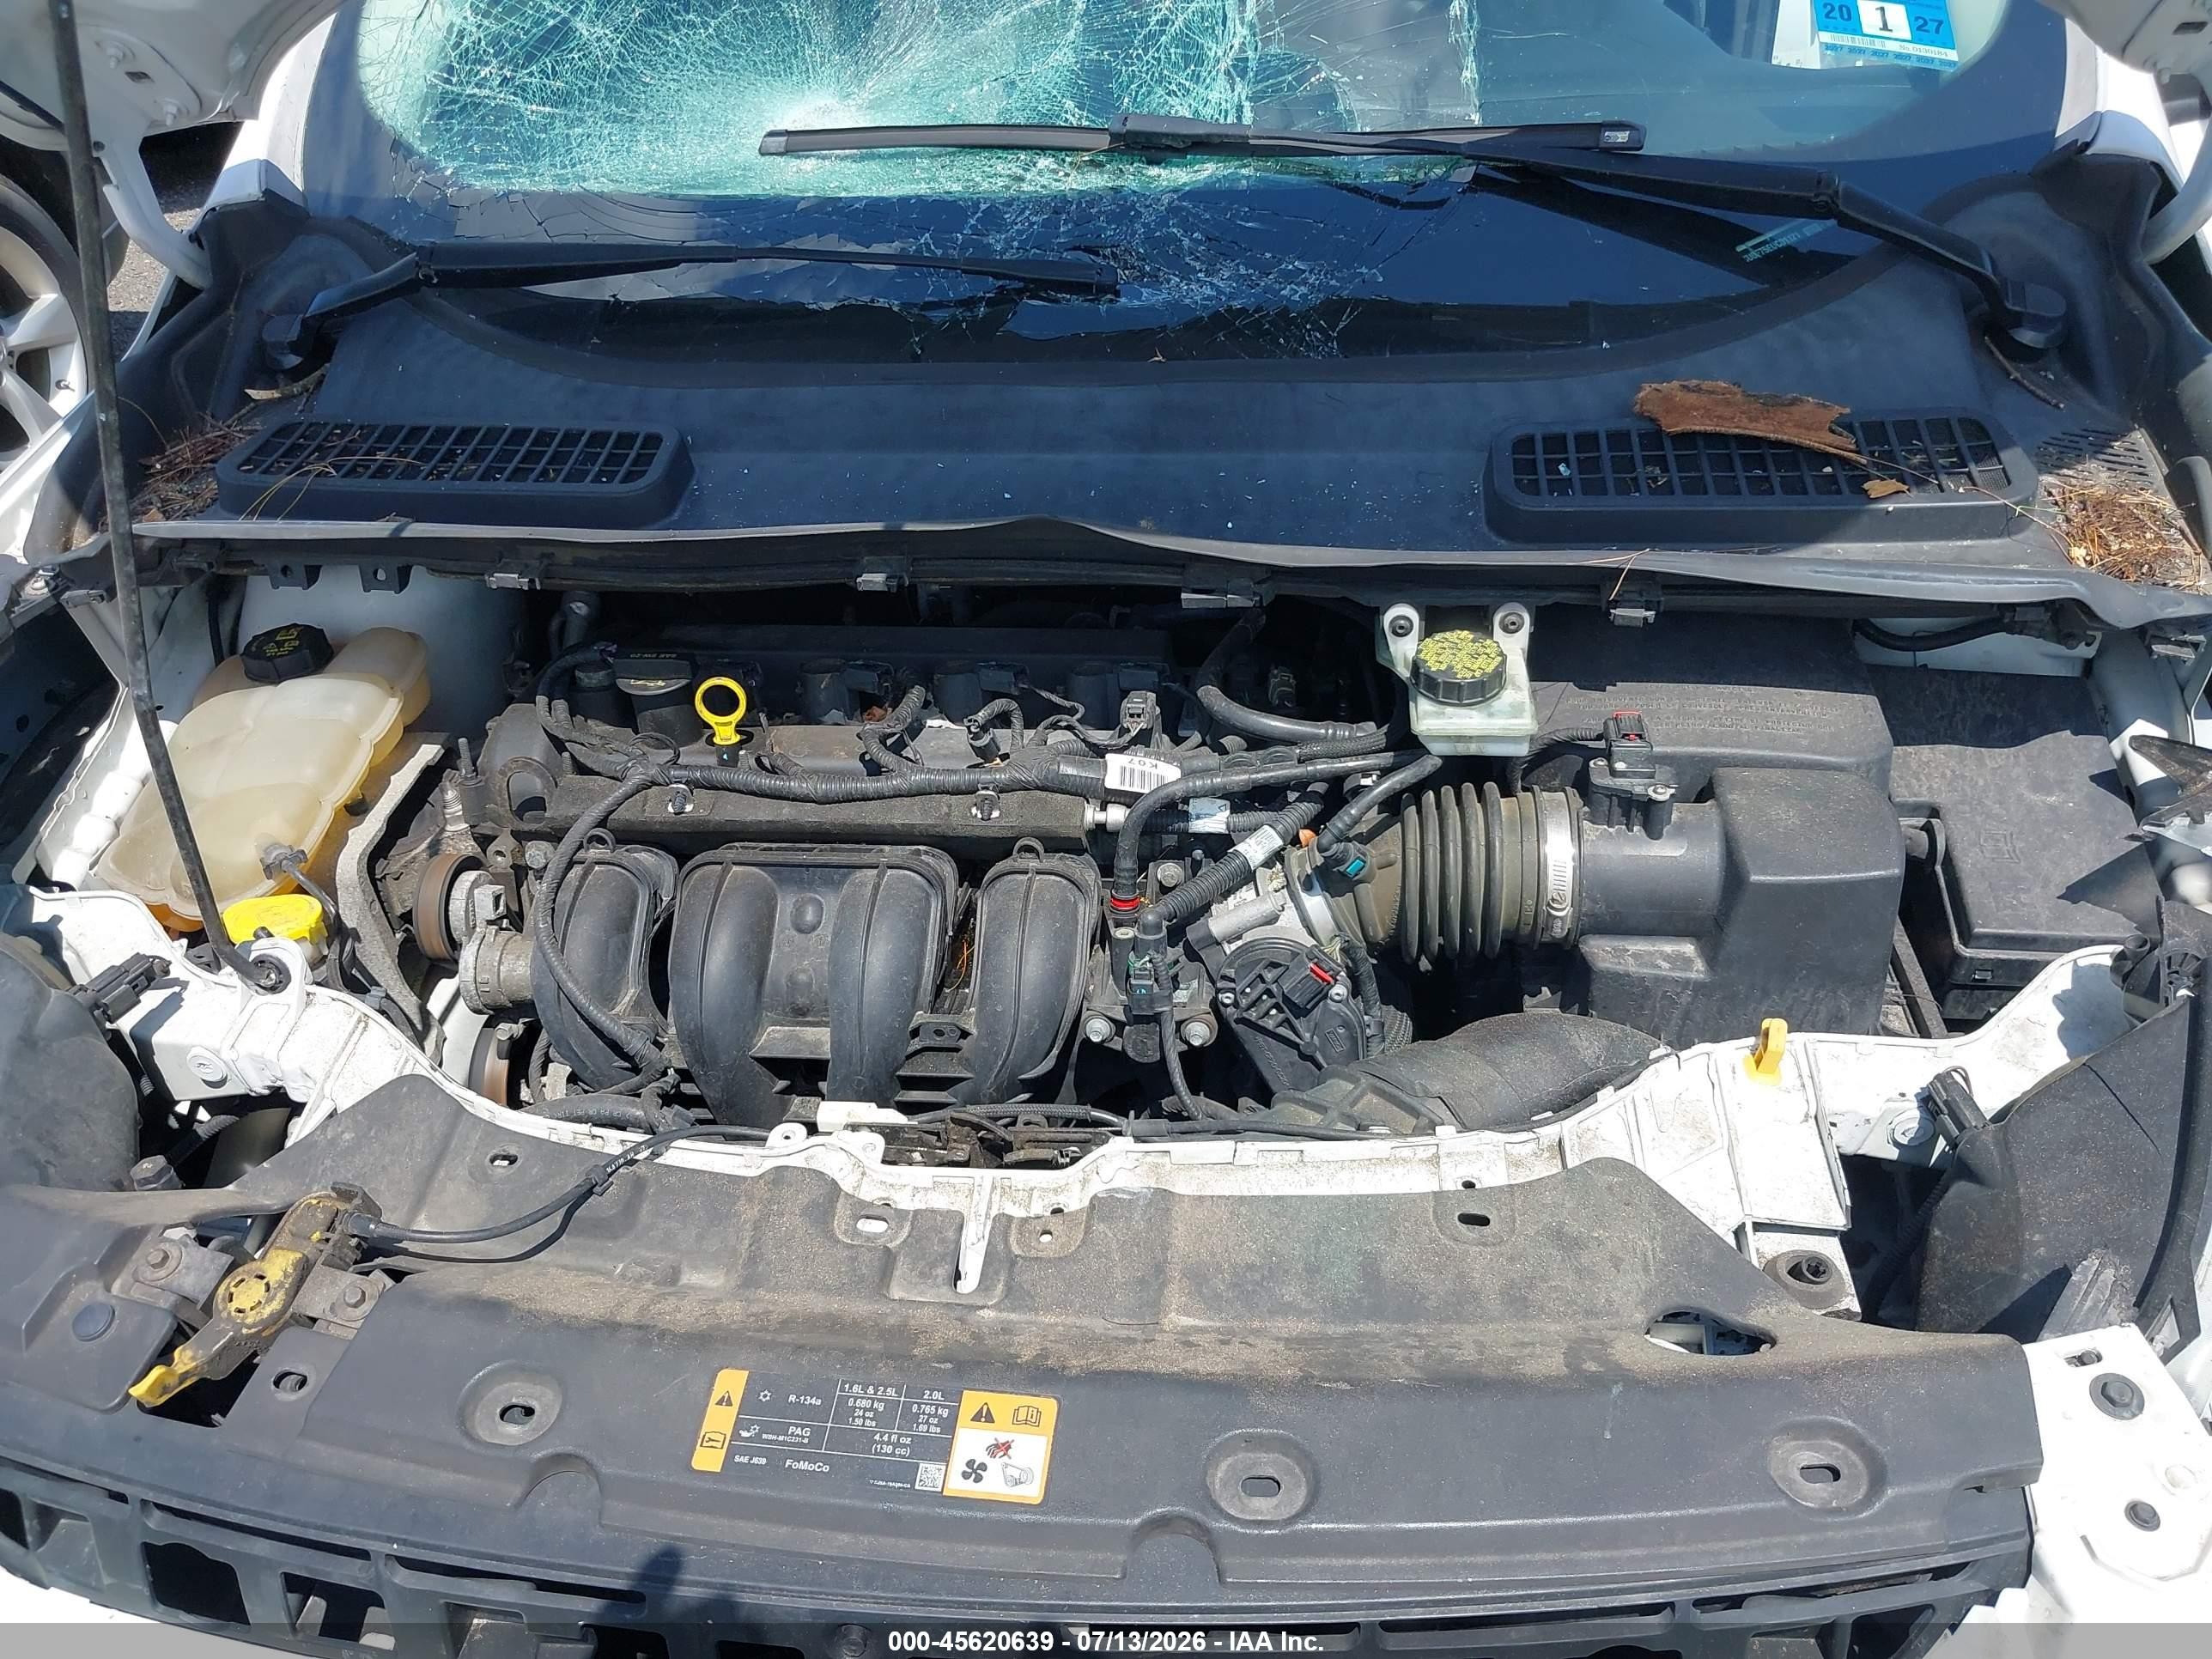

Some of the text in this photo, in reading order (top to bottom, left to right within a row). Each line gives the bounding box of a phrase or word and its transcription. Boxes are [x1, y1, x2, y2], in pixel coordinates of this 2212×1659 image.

[1823, 2, 1944, 35] 20 1 27
[843, 1382, 945, 1401] 1.6L & 2.5L 2.0L
[788, 1394, 822, 1407] R-134a
[848, 1398, 884, 1412] 0.680 kg
[912, 1404, 949, 1418] 0.765 kg
[865, 1419, 876, 1427] lbs
[929, 1425, 940, 1433] lbs
[788, 1426, 811, 1437] PAG
[874, 1431, 888, 1442] 4.4
[890, 1434, 897, 1443] fl
[872, 1443, 910, 1456] (130 cc)
[734, 1455, 749, 1464] SAE
[786, 1459, 830, 1473] FoMoCo
